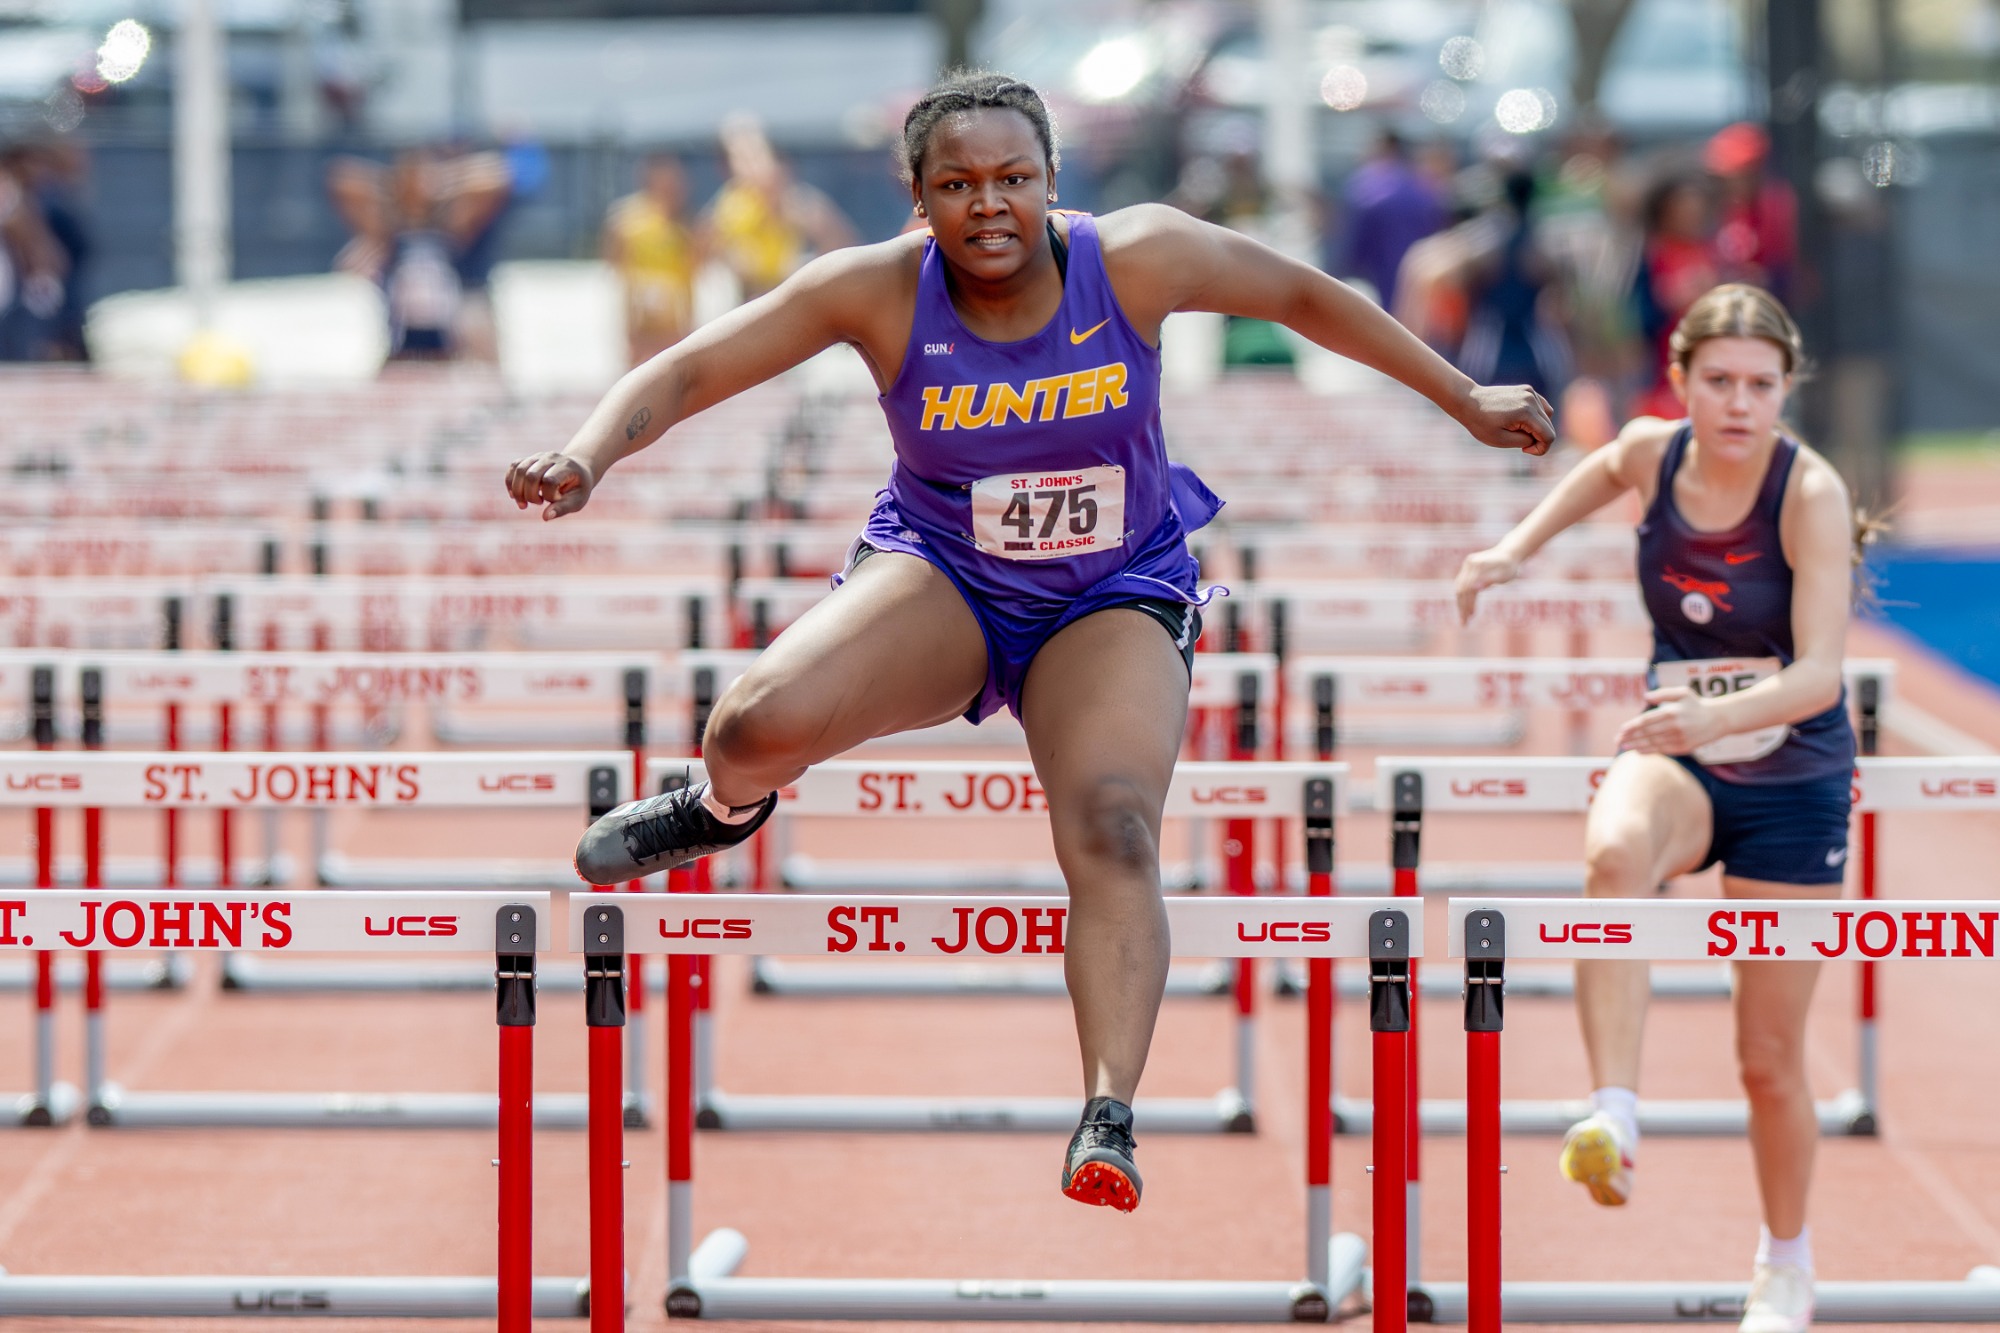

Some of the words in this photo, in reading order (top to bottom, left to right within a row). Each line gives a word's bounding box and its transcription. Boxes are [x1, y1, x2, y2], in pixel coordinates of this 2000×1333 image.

[920, 361, 1129, 431] HUNTER
[1010, 478, 1032, 489] ST.
[1035, 475, 1083, 488] JOHN'S
[1001, 484, 1098, 538] 475
[1040, 536, 1095, 551] CLASSIC
[7, 773, 82, 791] UCS
[144, 764, 207, 801] ST.
[232, 764, 421, 801] JOHN'S
[479, 774, 557, 792] UCS
[858, 772, 922, 811] ST.
[943, 773, 1049, 812] JOH
[1451, 779, 1527, 797] UCS
[1920, 779, 1998, 798] UCS
[1191, 786, 1267, 805] UCS
[59, 900, 293, 949] JOHN'S
[364, 916, 458, 937] UCS
[659, 918, 753, 940] UCS
[827, 906, 906, 953] ST.
[931, 906, 1067, 954] JOH
[1237, 922, 1331, 942] UCS
[1539, 923, 1632, 944] UCS
[1707, 910, 1786, 957] ST.
[233, 1290, 330, 1311] UCS
[1675, 1297, 1749, 1317] UC
